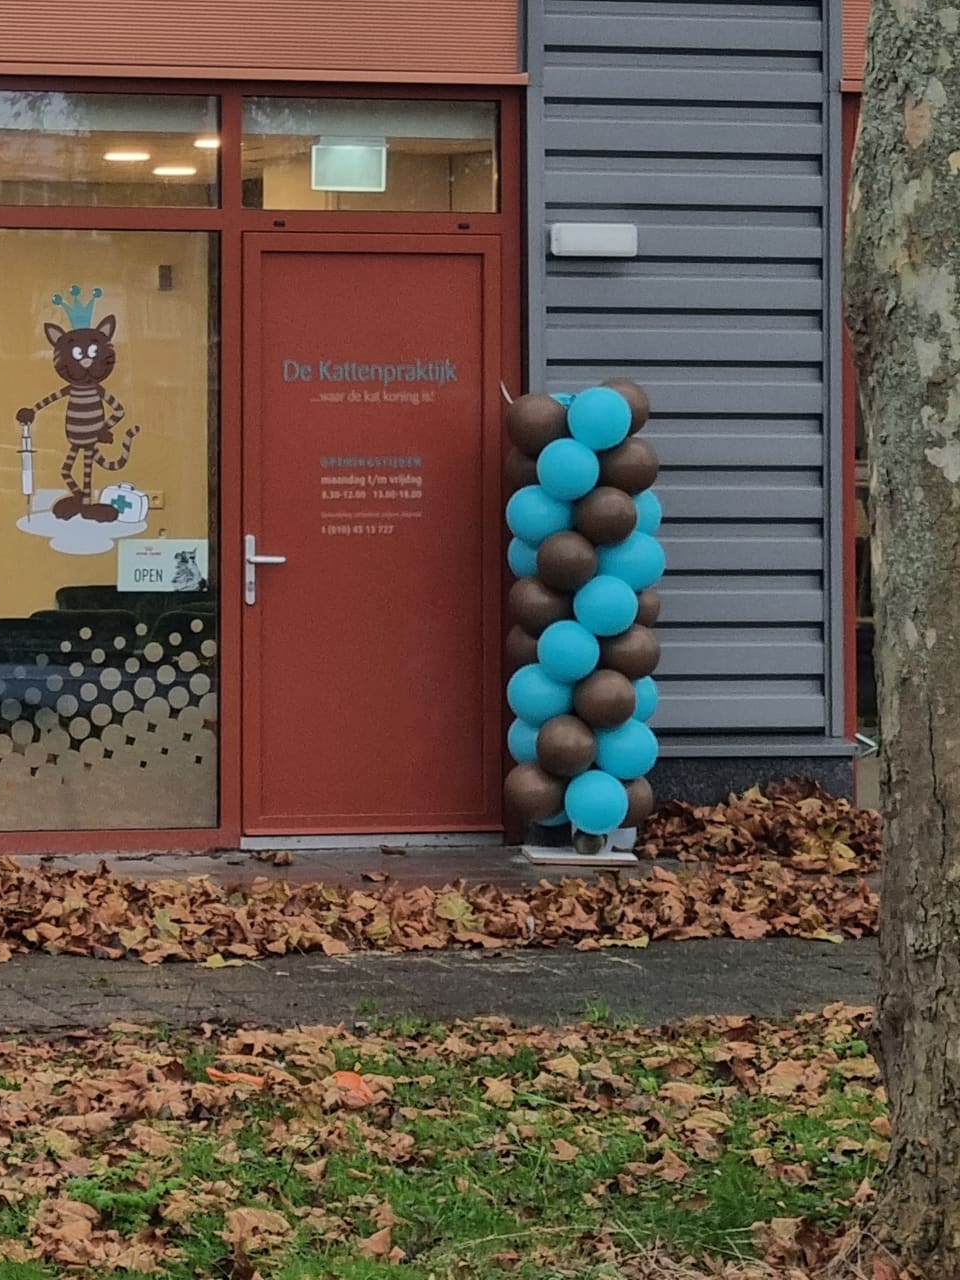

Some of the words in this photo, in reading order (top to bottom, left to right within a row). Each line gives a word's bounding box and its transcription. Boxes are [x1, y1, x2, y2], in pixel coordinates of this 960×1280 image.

[283, 358, 312, 382] De
[319, 358, 457, 387] Kattenpraktijk
[347, 390, 362, 403] de
[364, 390, 381, 403] kat
[383, 390, 420, 406] koning
[321, 474, 366, 487] maandag
[367, 474, 387, 487] t/m
[389, 474, 423, 487] vrijdag
[134, 568, 163, 582] OPEN
